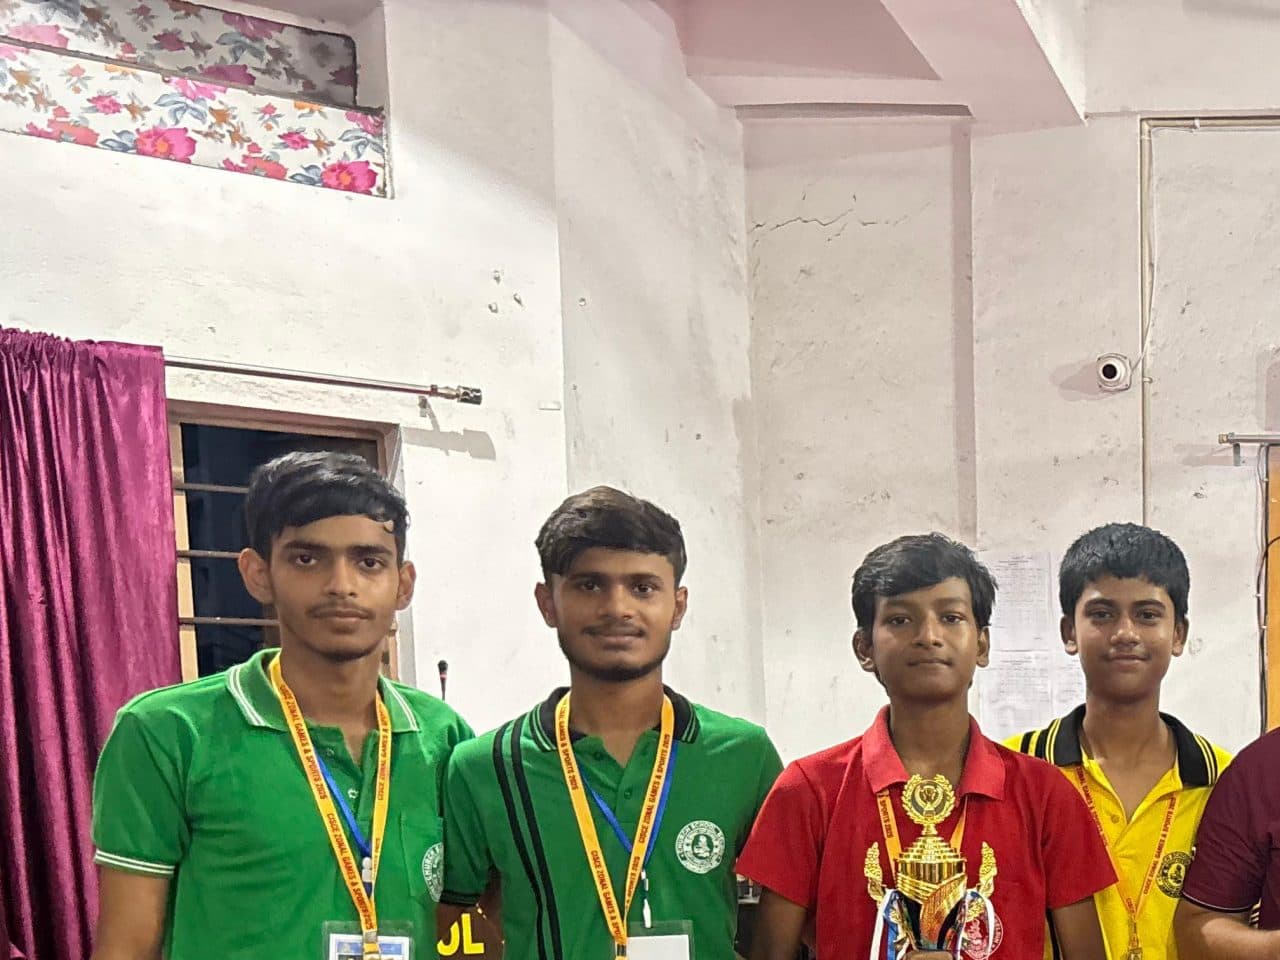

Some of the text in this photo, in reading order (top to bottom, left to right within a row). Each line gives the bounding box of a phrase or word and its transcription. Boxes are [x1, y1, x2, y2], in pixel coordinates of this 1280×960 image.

[285, 699, 300, 722] ZONAL
[294, 722, 309, 746] GAMES
[305, 754, 321, 782] SPORTS
[315, 782, 327, 800] 2025
[662, 733, 670, 748] 2025
[562, 748, 574, 773] SPORTS
[568, 774, 578, 790] 2025
[656, 748, 667, 772] SPORTS
[648, 780, 659, 802] GAMES
[643, 803, 654, 824] ZONAL
[879, 799, 889, 822] SPORTS
[638, 825, 648, 843] CISCE
[326, 812, 340, 832] CISCE
[333, 832, 348, 855] ZONAL
[341, 855, 357, 880] GAMES
[352, 886, 368, 914] SPORTS
[631, 855, 640, 870] 2025
[590, 849, 601, 868] CISCE
[596, 869, 608, 890] ZONAL
[602, 891, 614, 913] GAMES
